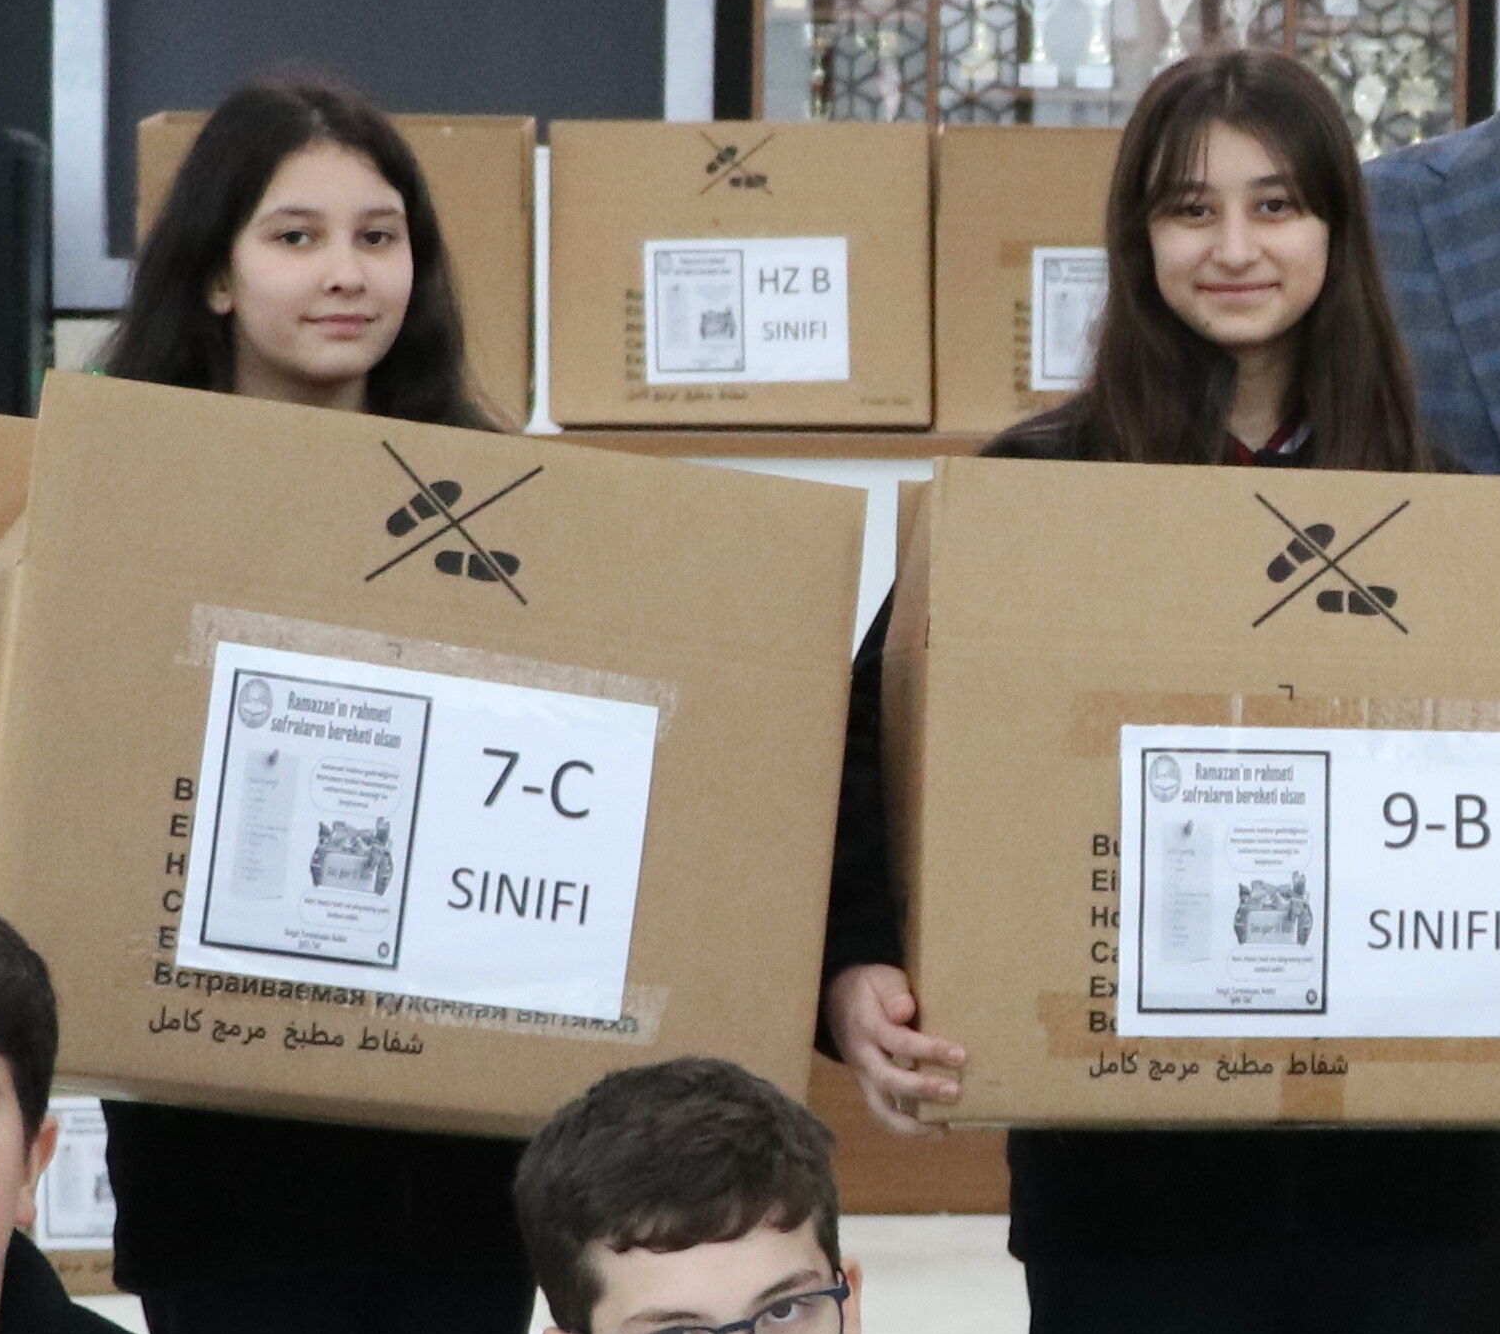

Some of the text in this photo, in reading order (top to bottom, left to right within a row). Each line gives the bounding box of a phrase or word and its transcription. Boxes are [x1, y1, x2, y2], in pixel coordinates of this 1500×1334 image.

[758, 266, 831, 295] HZ B
[482, 747, 594, 820] 7-C
[1382, 792, 1491, 850] 9-B
[447, 867, 590, 925] SINIFI
[1367, 909, 1500, 951] SINIFI
